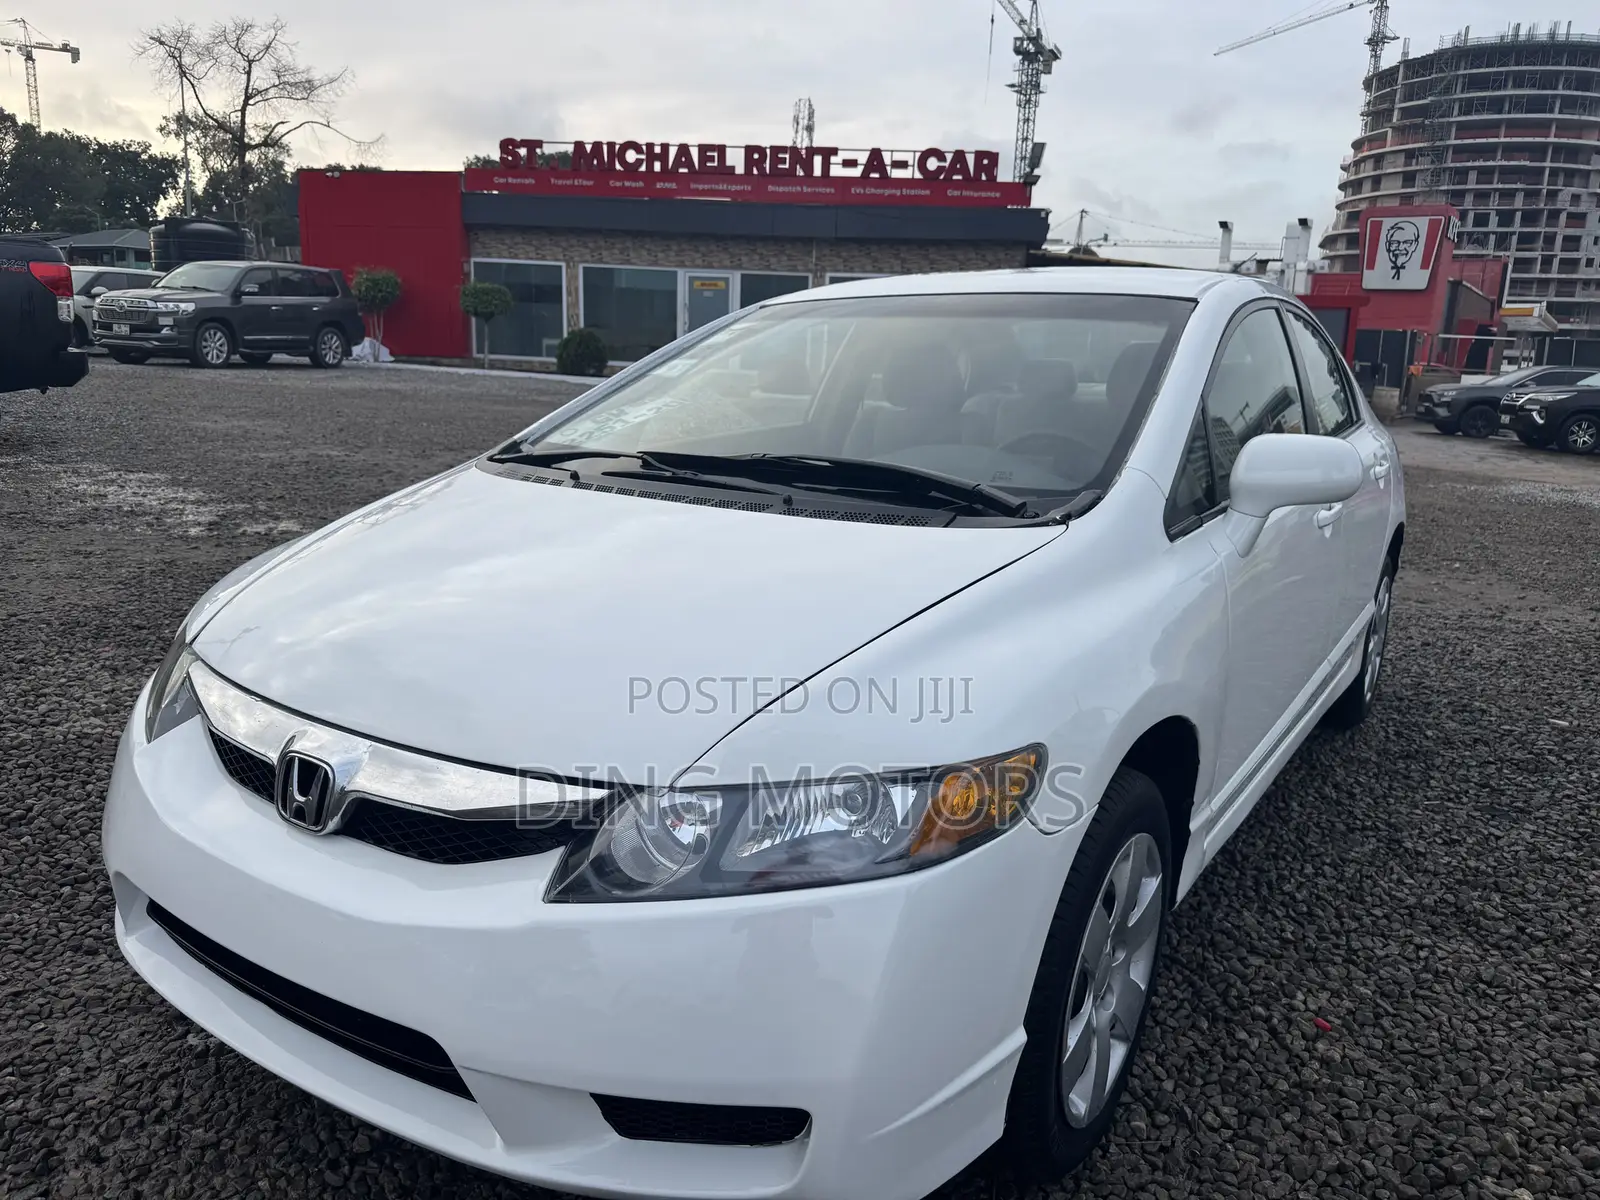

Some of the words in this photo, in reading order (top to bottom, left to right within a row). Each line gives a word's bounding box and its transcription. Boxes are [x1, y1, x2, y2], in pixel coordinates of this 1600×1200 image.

[571, 140, 736, 174] MICHAEL
[744, 144, 999, 182] RENT-A-CAR
[493, 176, 506, 184] Car
[507, 177, 536, 185] Rentals
[550, 177, 573, 186] Travel
[609, 180, 623, 188] Car
[624, 180, 645, 188] Wash
[767, 184, 802, 193] Dispatch
[803, 185, 836, 194] Services
[865, 187, 901, 197] Charging
[902, 188, 931, 196] Station
[946, 189, 961, 197] Car
[962, 190, 1002, 198] Insurance
